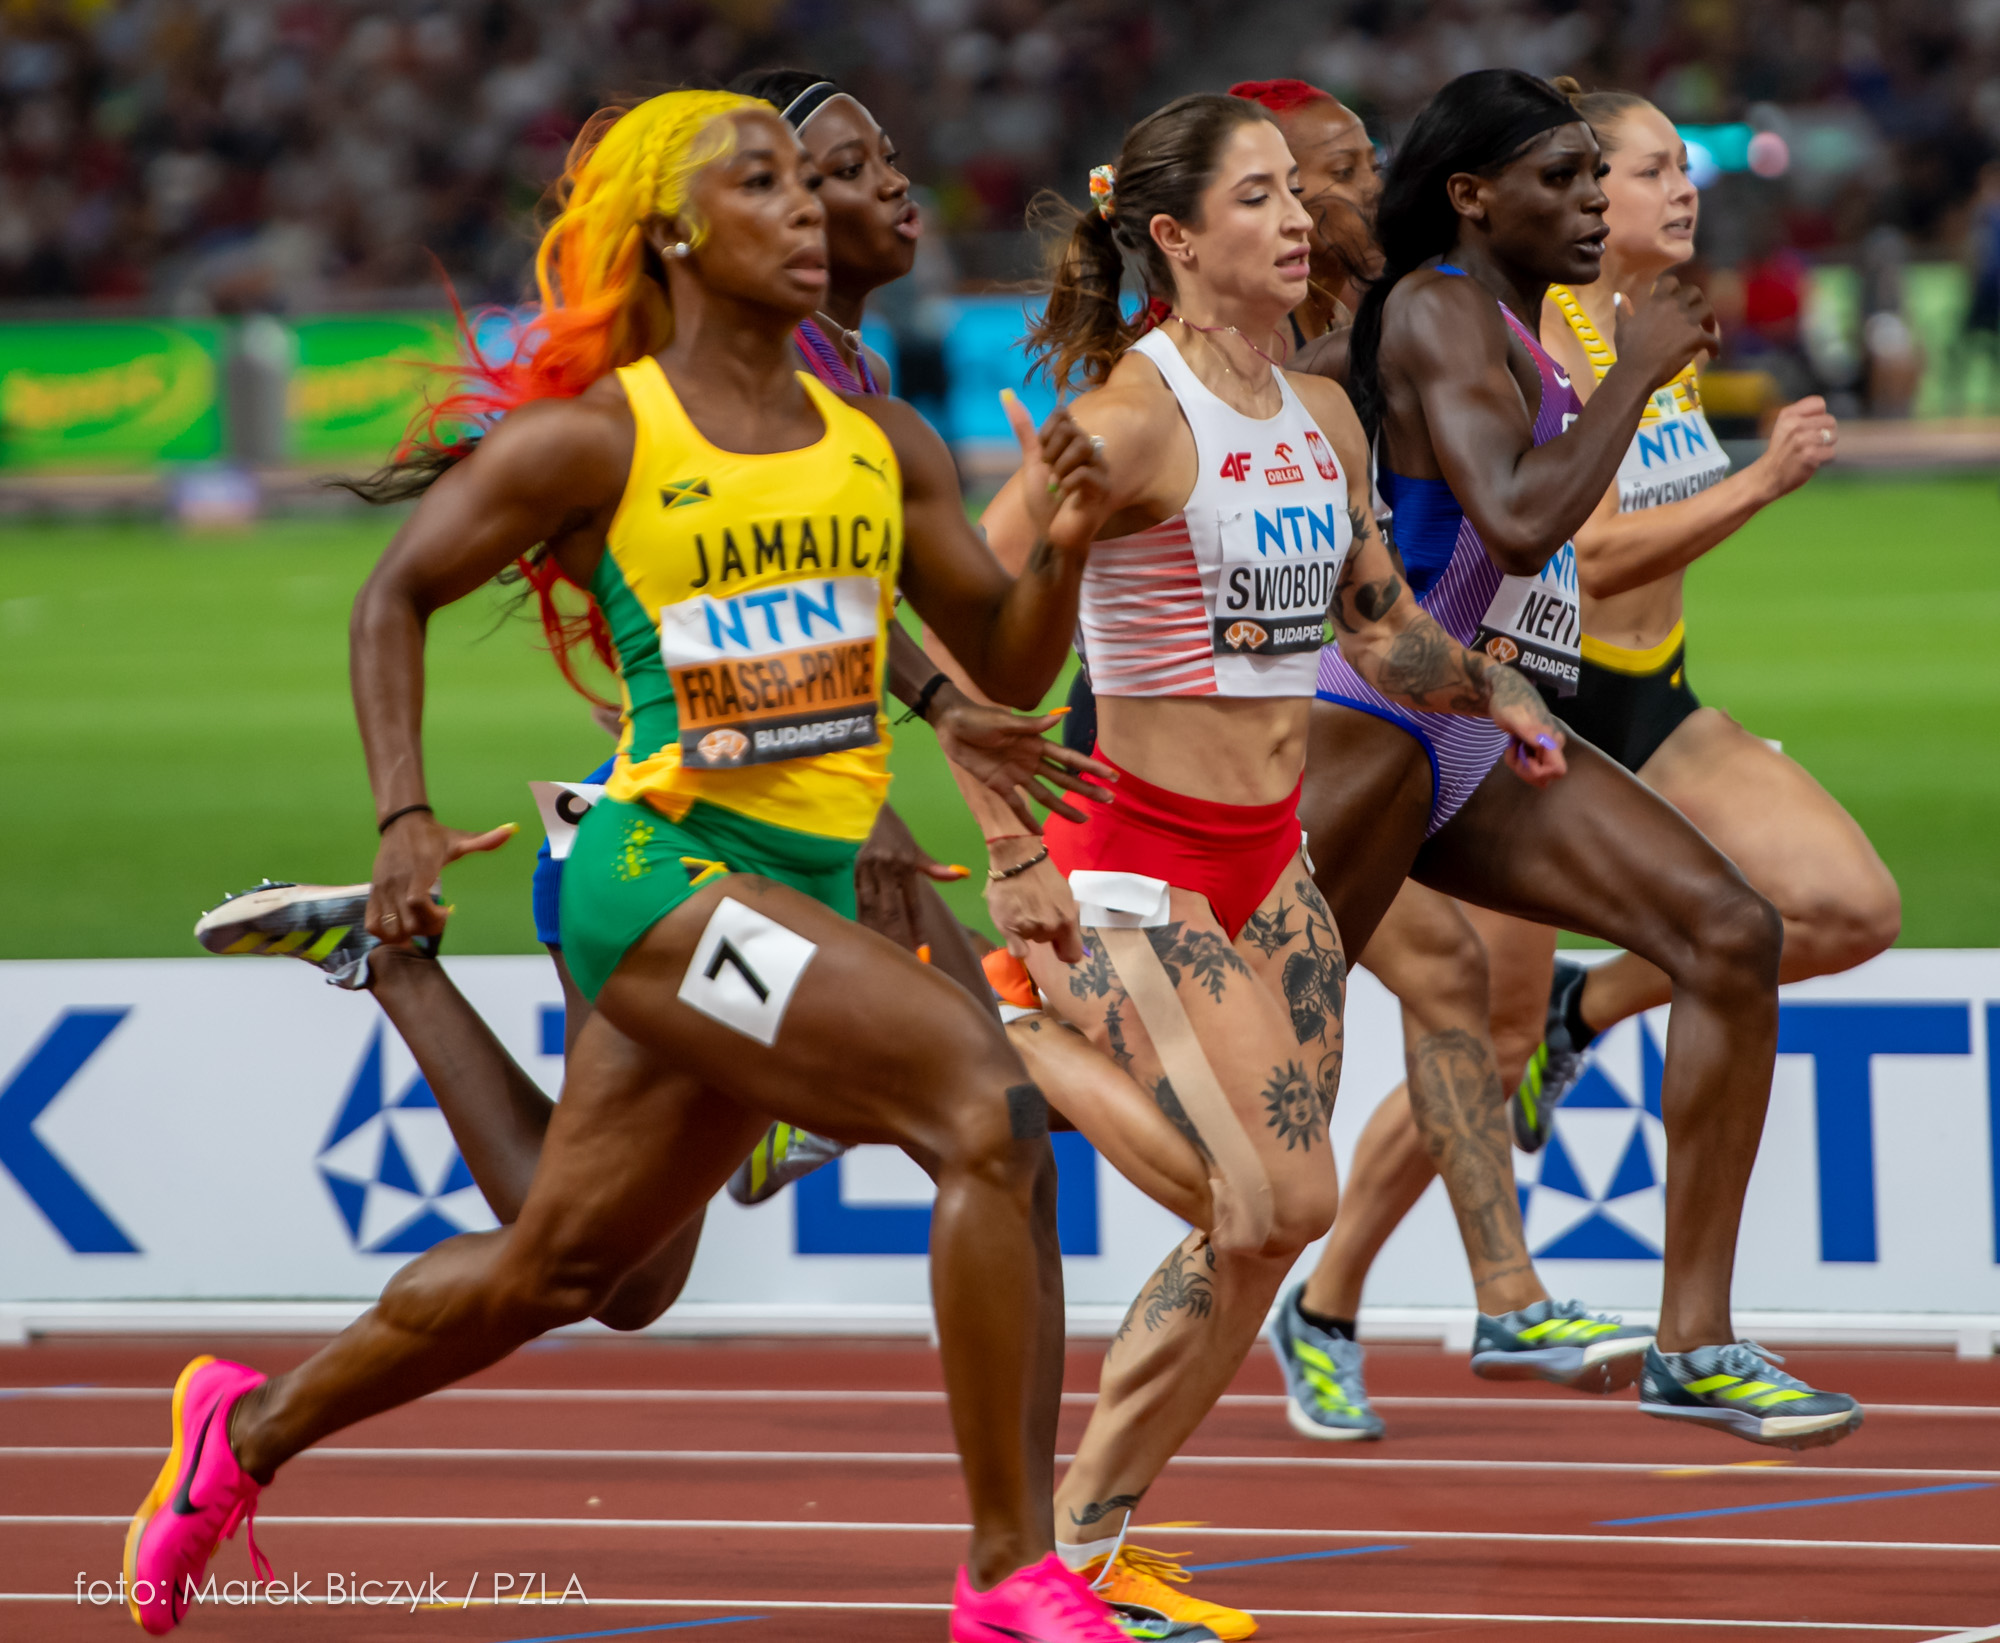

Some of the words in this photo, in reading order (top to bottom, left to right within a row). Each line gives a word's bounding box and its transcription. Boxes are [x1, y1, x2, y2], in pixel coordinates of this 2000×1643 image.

[1219, 452, 1252, 482] 4F
[1636, 414, 1709, 469] NTN
[1266, 467, 1302, 483] ORLEN
[690, 514, 890, 589] JAMAICA
[1254, 503, 1336, 557] NTN
[1226, 558, 1341, 611] SWOBOD
[703, 581, 844, 651] NTN
[680, 645, 874, 720] FRASER-PRYCE
[704, 935, 770, 1005] 7
